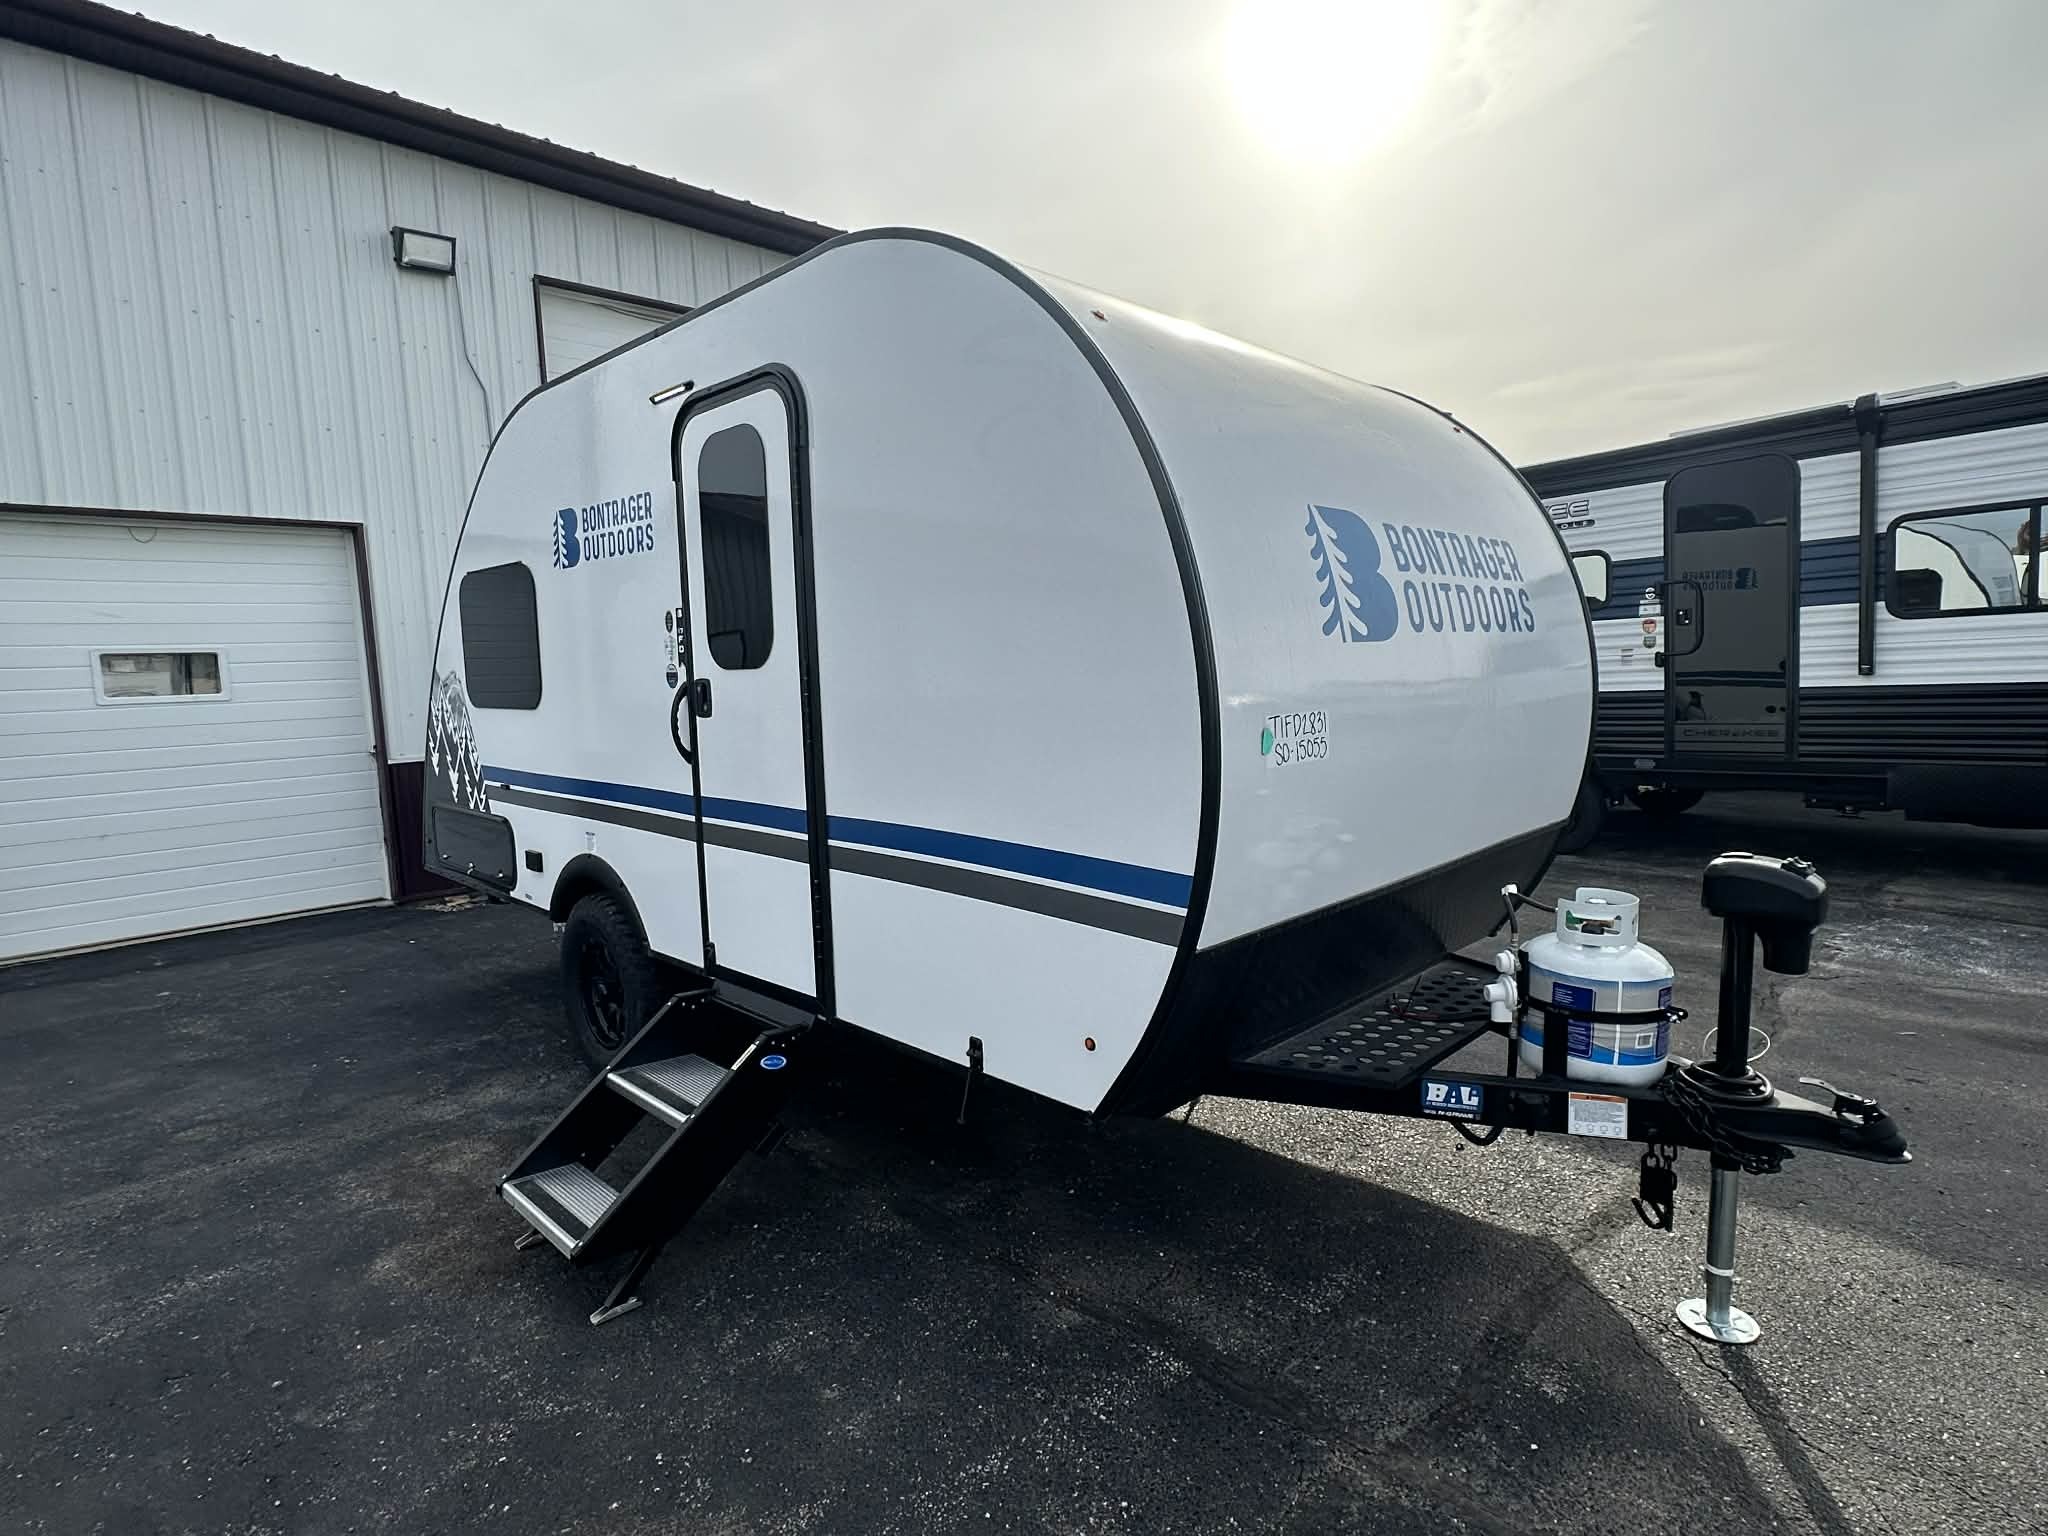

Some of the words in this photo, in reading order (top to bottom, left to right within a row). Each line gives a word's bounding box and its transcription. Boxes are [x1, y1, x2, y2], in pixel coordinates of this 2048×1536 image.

[582, 491, 652, 533] BONTRAGER
[583, 525, 654, 561] OUTDOORS
[1382, 523, 1524, 582] BONTRAGER
[1403, 580, 1535, 632] OUTDOORS
[1427, 1083, 1479, 1106] BAL
